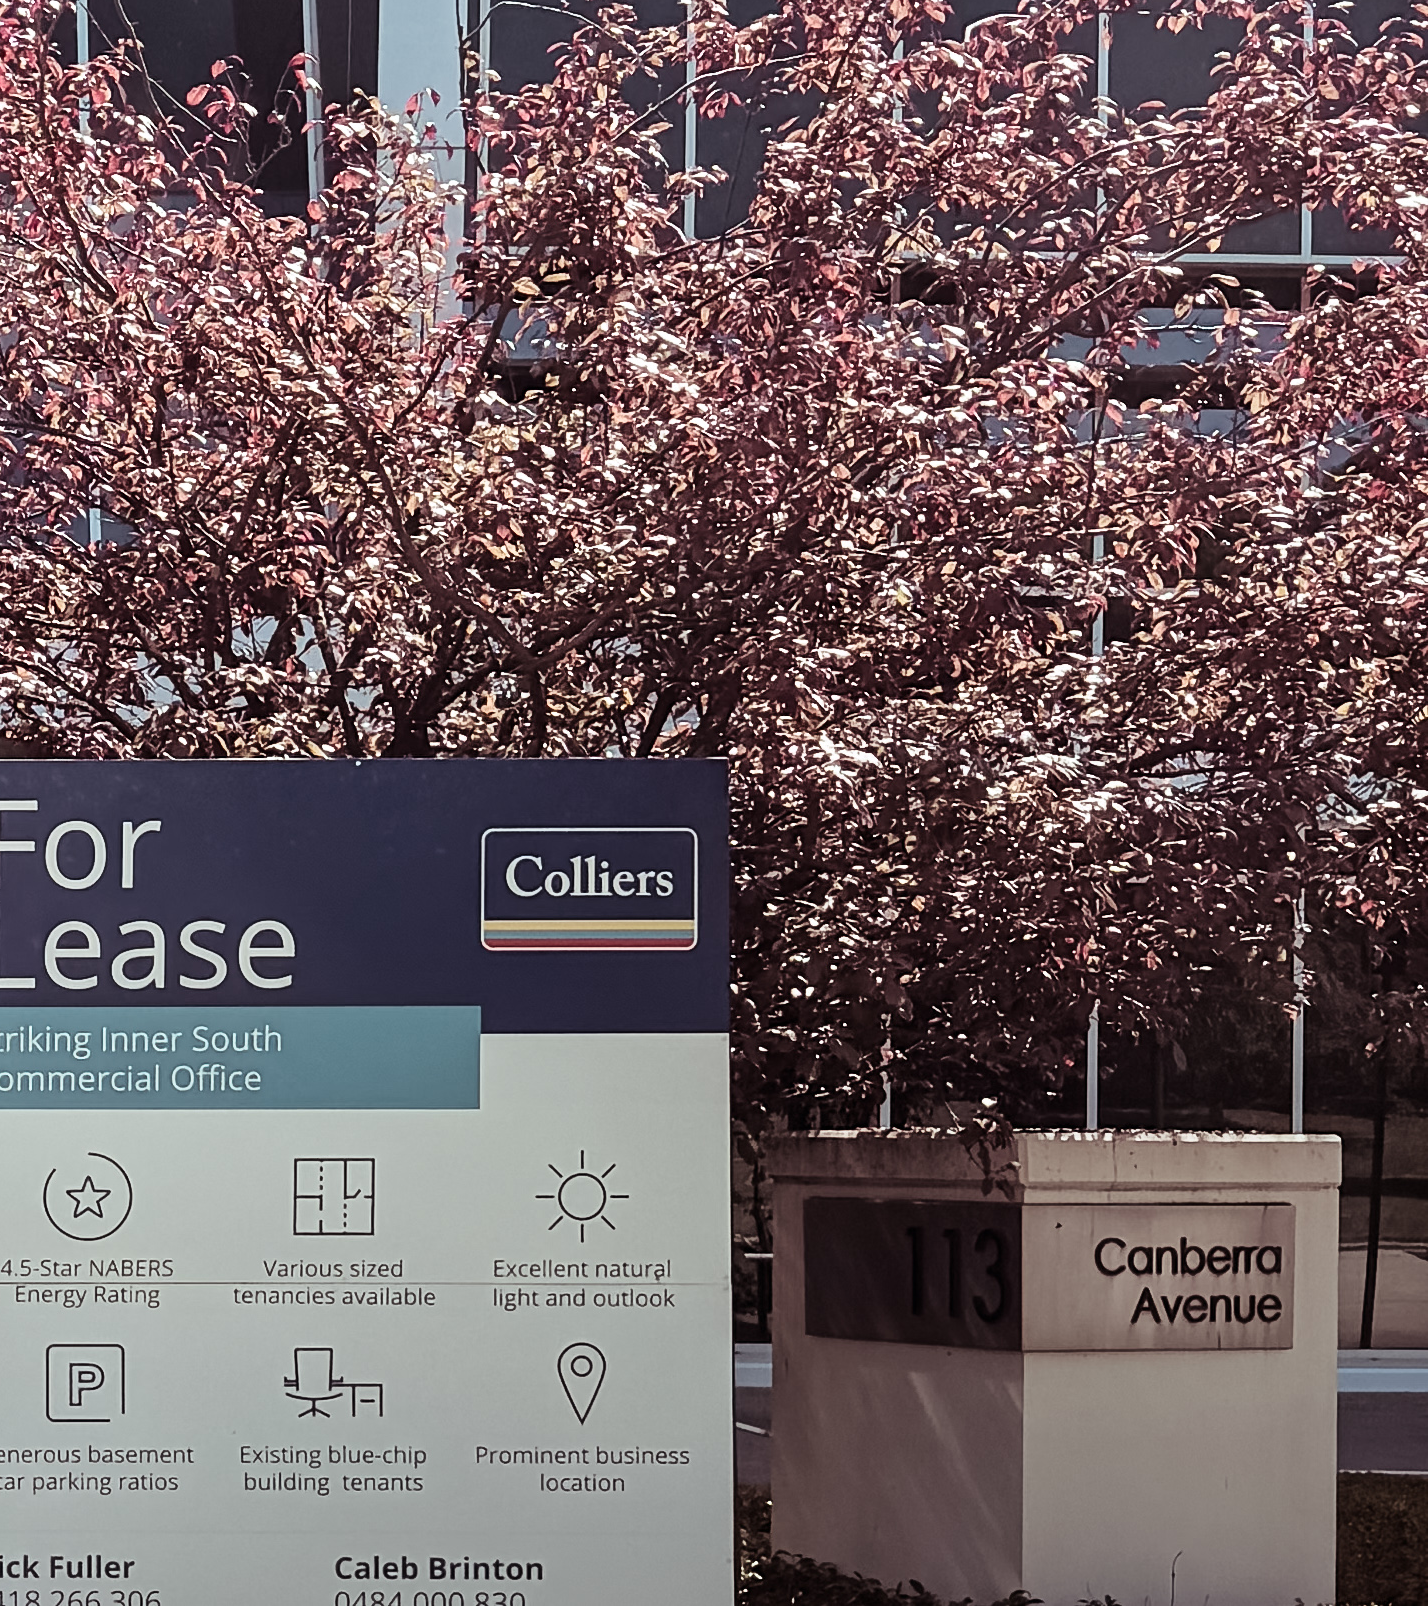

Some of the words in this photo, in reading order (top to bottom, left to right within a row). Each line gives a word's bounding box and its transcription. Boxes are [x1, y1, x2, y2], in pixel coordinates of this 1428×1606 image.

[505, 855, 674, 898] Colliers
[101, 1026, 183, 1053] Inner
[192, 1024, 282, 1053] South
[171, 1063, 262, 1092] Office
[0, 1258, 82, 1278] 4.5-Star
[89, 1258, 174, 1278] NABERS
[263, 1258, 343, 1278] Various
[349, 1258, 403, 1278] sized
[493, 1258, 589, 1278] Excellent
[595, 1258, 671, 1279] natural
[1094, 1236, 1283, 1277] Canberra
[906, 1226, 1008, 1324] 113
[15, 1285, 87, 1310] Energy
[94, 1285, 160, 1310] Rating
[233, 1286, 336, 1306] tenancies
[342, 1286, 436, 1306] available
[493, 1287, 540, 1312] light
[545, 1287, 586, 1308] and
[593, 1287, 676, 1308] outlook
[1130, 1286, 1283, 1325] Avenue
[88, 1444, 195, 1465] basement
[240, 1445, 322, 1469] Existing
[328, 1445, 427, 1469] blue-chip
[476, 1446, 590, 1466] Prominent
[596, 1445, 690, 1466] business
[32, 1471, 112, 1497] parking
[119, 1472, 179, 1492] ratios
[244, 1471, 330, 1497] building
[342, 1475, 424, 1493] tenants
[540, 1472, 625, 1493] location
[50, 1554, 136, 1579] Fuller
[335, 1555, 418, 1580] Caleb
[429, 1556, 543, 1581] Brinton
[50, 1590, 100, 1606] 266
[110, 1590, 161, 1606] 306
